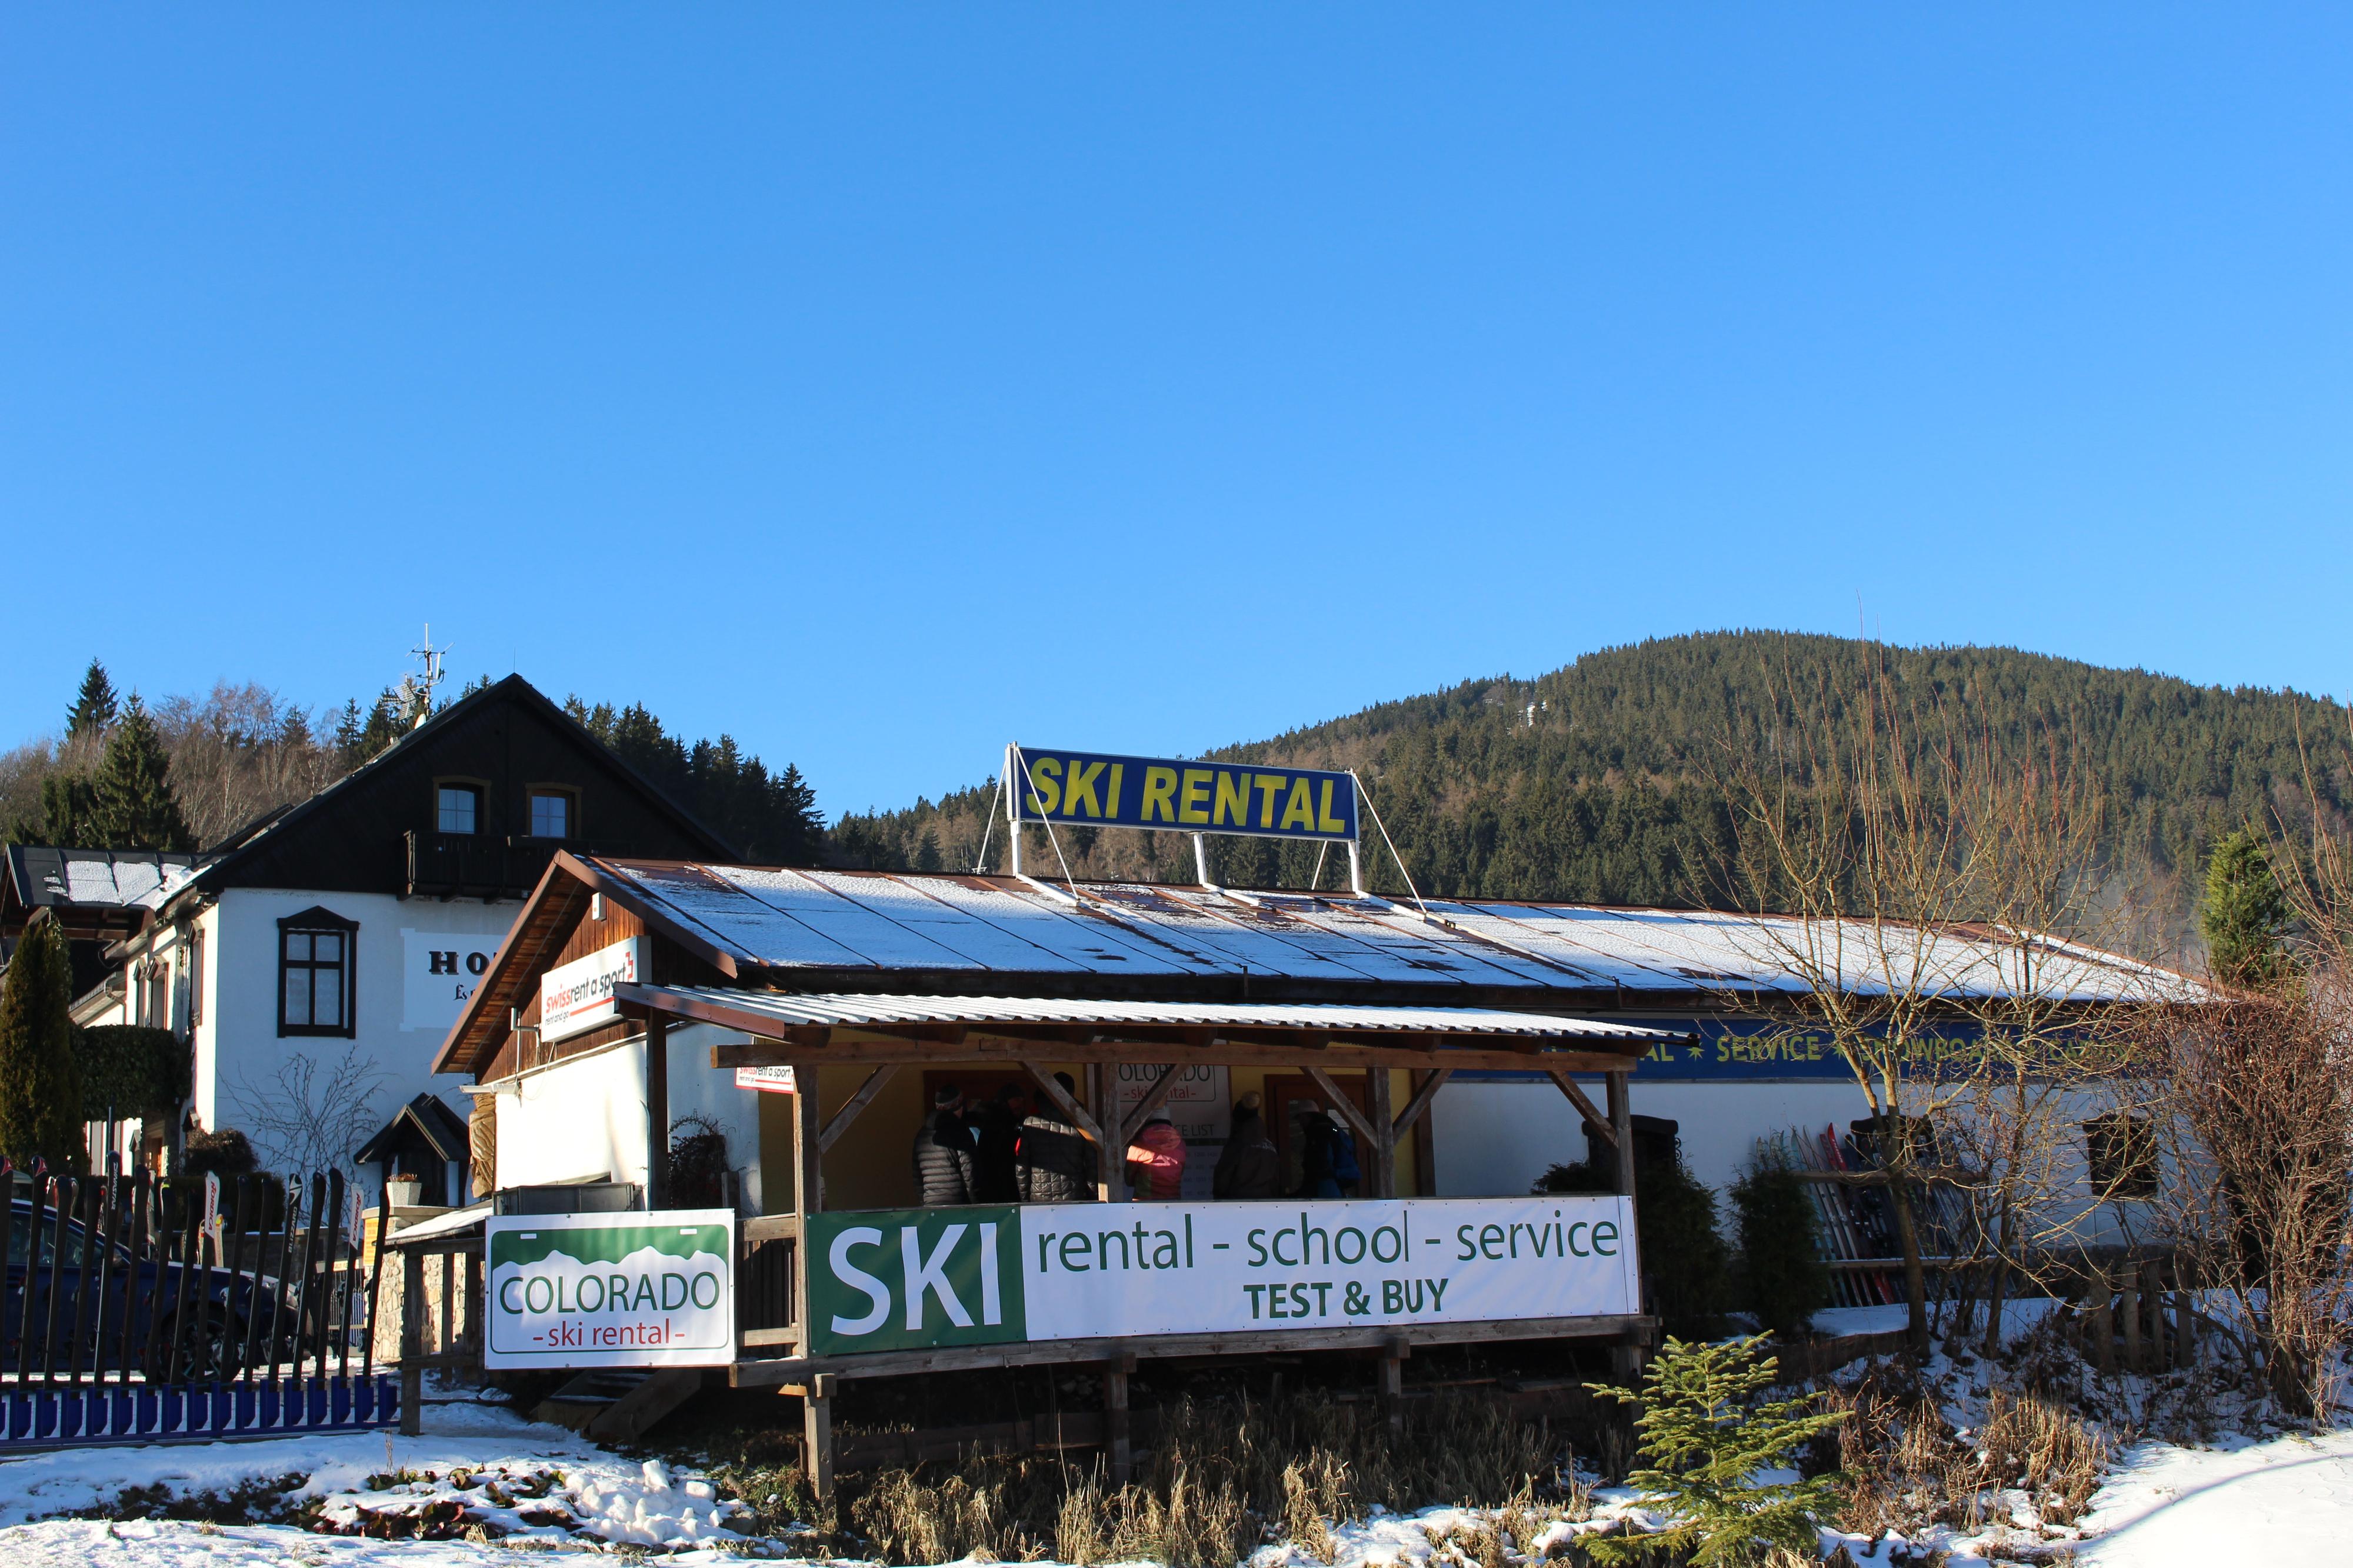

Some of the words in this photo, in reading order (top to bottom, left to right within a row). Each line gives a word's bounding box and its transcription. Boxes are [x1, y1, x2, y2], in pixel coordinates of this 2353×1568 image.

[1026, 757, 1122, 818] SKI
[1141, 766, 1345, 833] RENTAL
[429, 951, 497, 976] HO
[546, 978, 589, 1014] swissrent
[591, 978, 597, 996] a
[599, 962, 626, 998] sport
[545, 1014, 554, 1026] rent
[554, 1012, 563, 1023] and
[562, 1010, 569, 1023] go
[1717, 1036, 1821, 1062] SERVICE
[768, 1067, 773, 1076] a
[774, 1067, 791, 1080] sport
[1119, 1063, 1210, 1082] OLORDO
[1192, 1124, 1215, 1136] LIST
[288, 1206, 298, 1253] BLIZZARD
[353, 1193, 361, 1242] NORDICA
[499, 1271, 720, 1315] COLORADO
[829, 1222, 1001, 1336] SKI
[1038, 1213, 1193, 1272] rental
[1247, 1210, 1409, 1267] school
[1457, 1210, 1618, 1261] service
[1243, 1282, 1333, 1319] TEST
[1343, 1280, 1371, 1316] &
[1382, 1278, 1449, 1315] BUY
